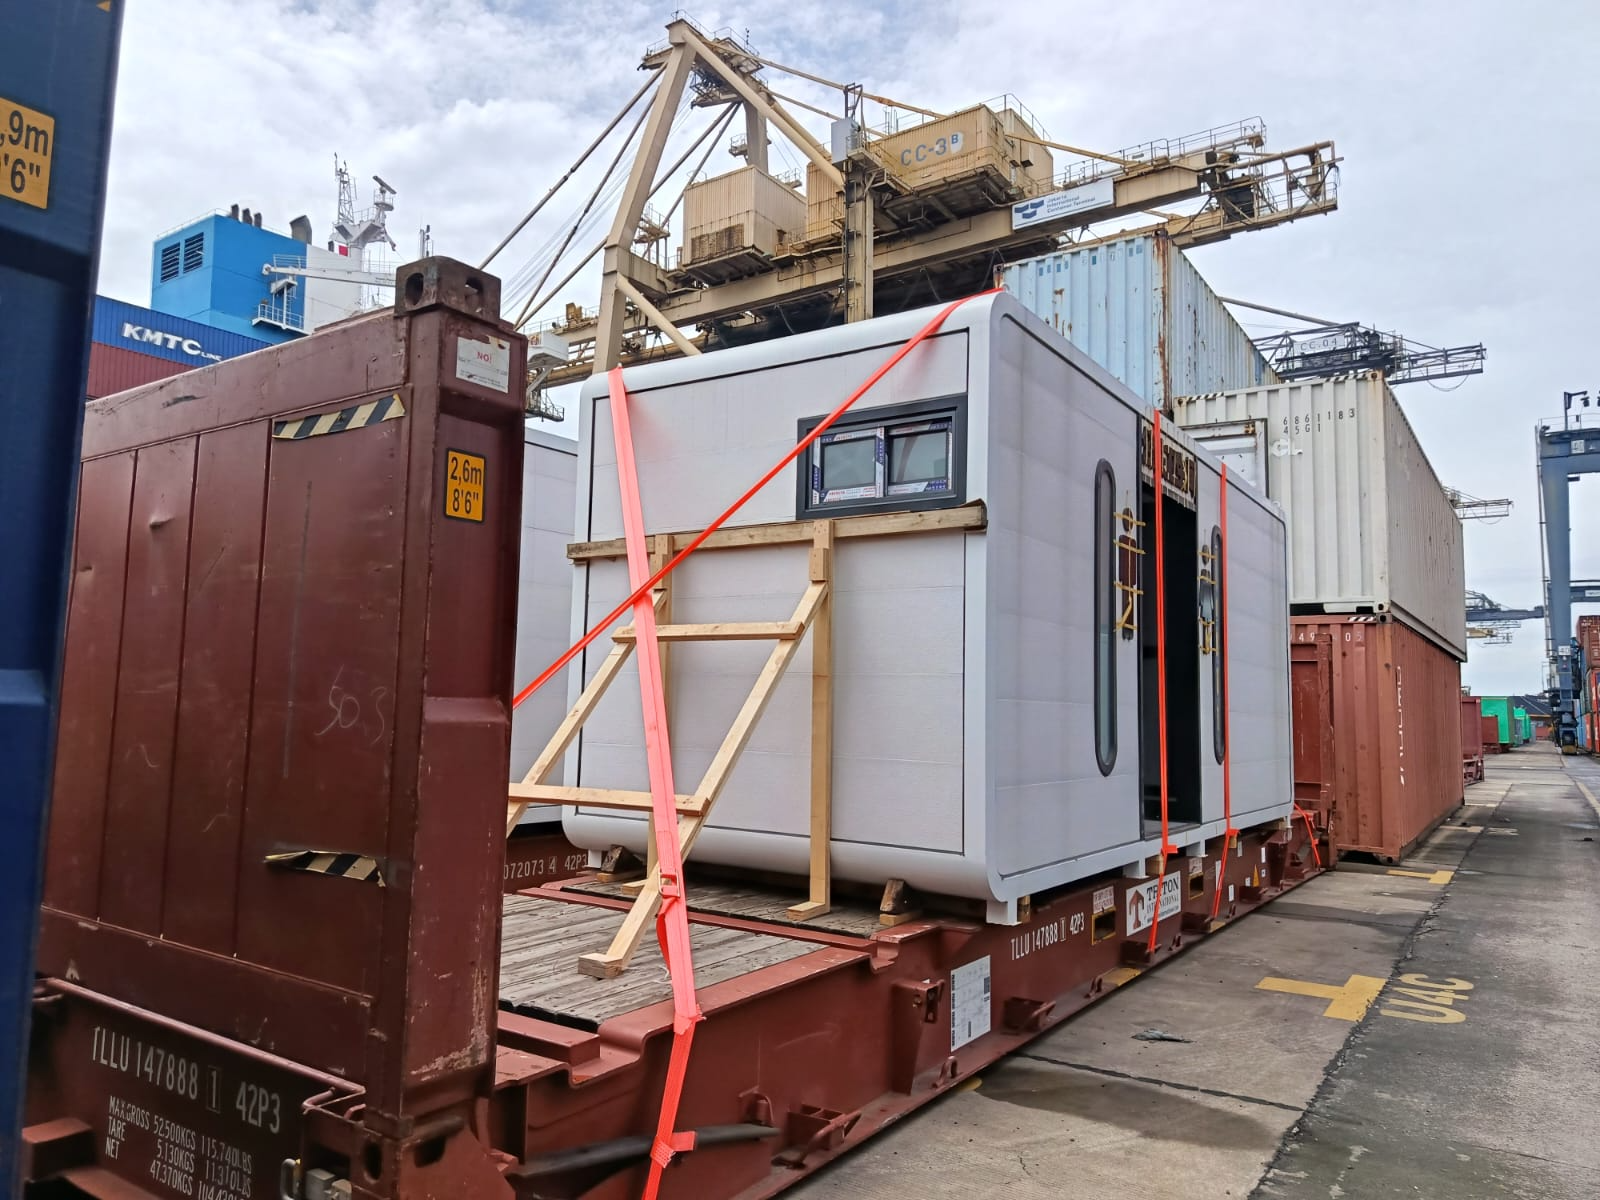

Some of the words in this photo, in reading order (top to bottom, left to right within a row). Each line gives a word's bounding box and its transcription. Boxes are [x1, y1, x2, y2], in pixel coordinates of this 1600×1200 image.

[0, 153, 41, 194] '6"
[122, 322, 201, 356] KMTC
[450, 456, 483, 487] 2,6m
[452, 488, 479, 515] 8'6"
[549, 856, 557, 874] 4
[564, 853, 587, 872] 42P3
[1010, 932, 1030, 960] TLLU
[1032, 922, 1058, 952] 147888
[1070, 911, 1085, 935] 42P3
[92, 1026, 131, 1072] TLLU
[136, 1041, 199, 1100] 147888
[209, 1067, 219, 1111] 1
[235, 1080, 281, 1134] 42P3
[108, 1116, 127, 1142] TARE
[105, 1136, 120, 1160] NET
